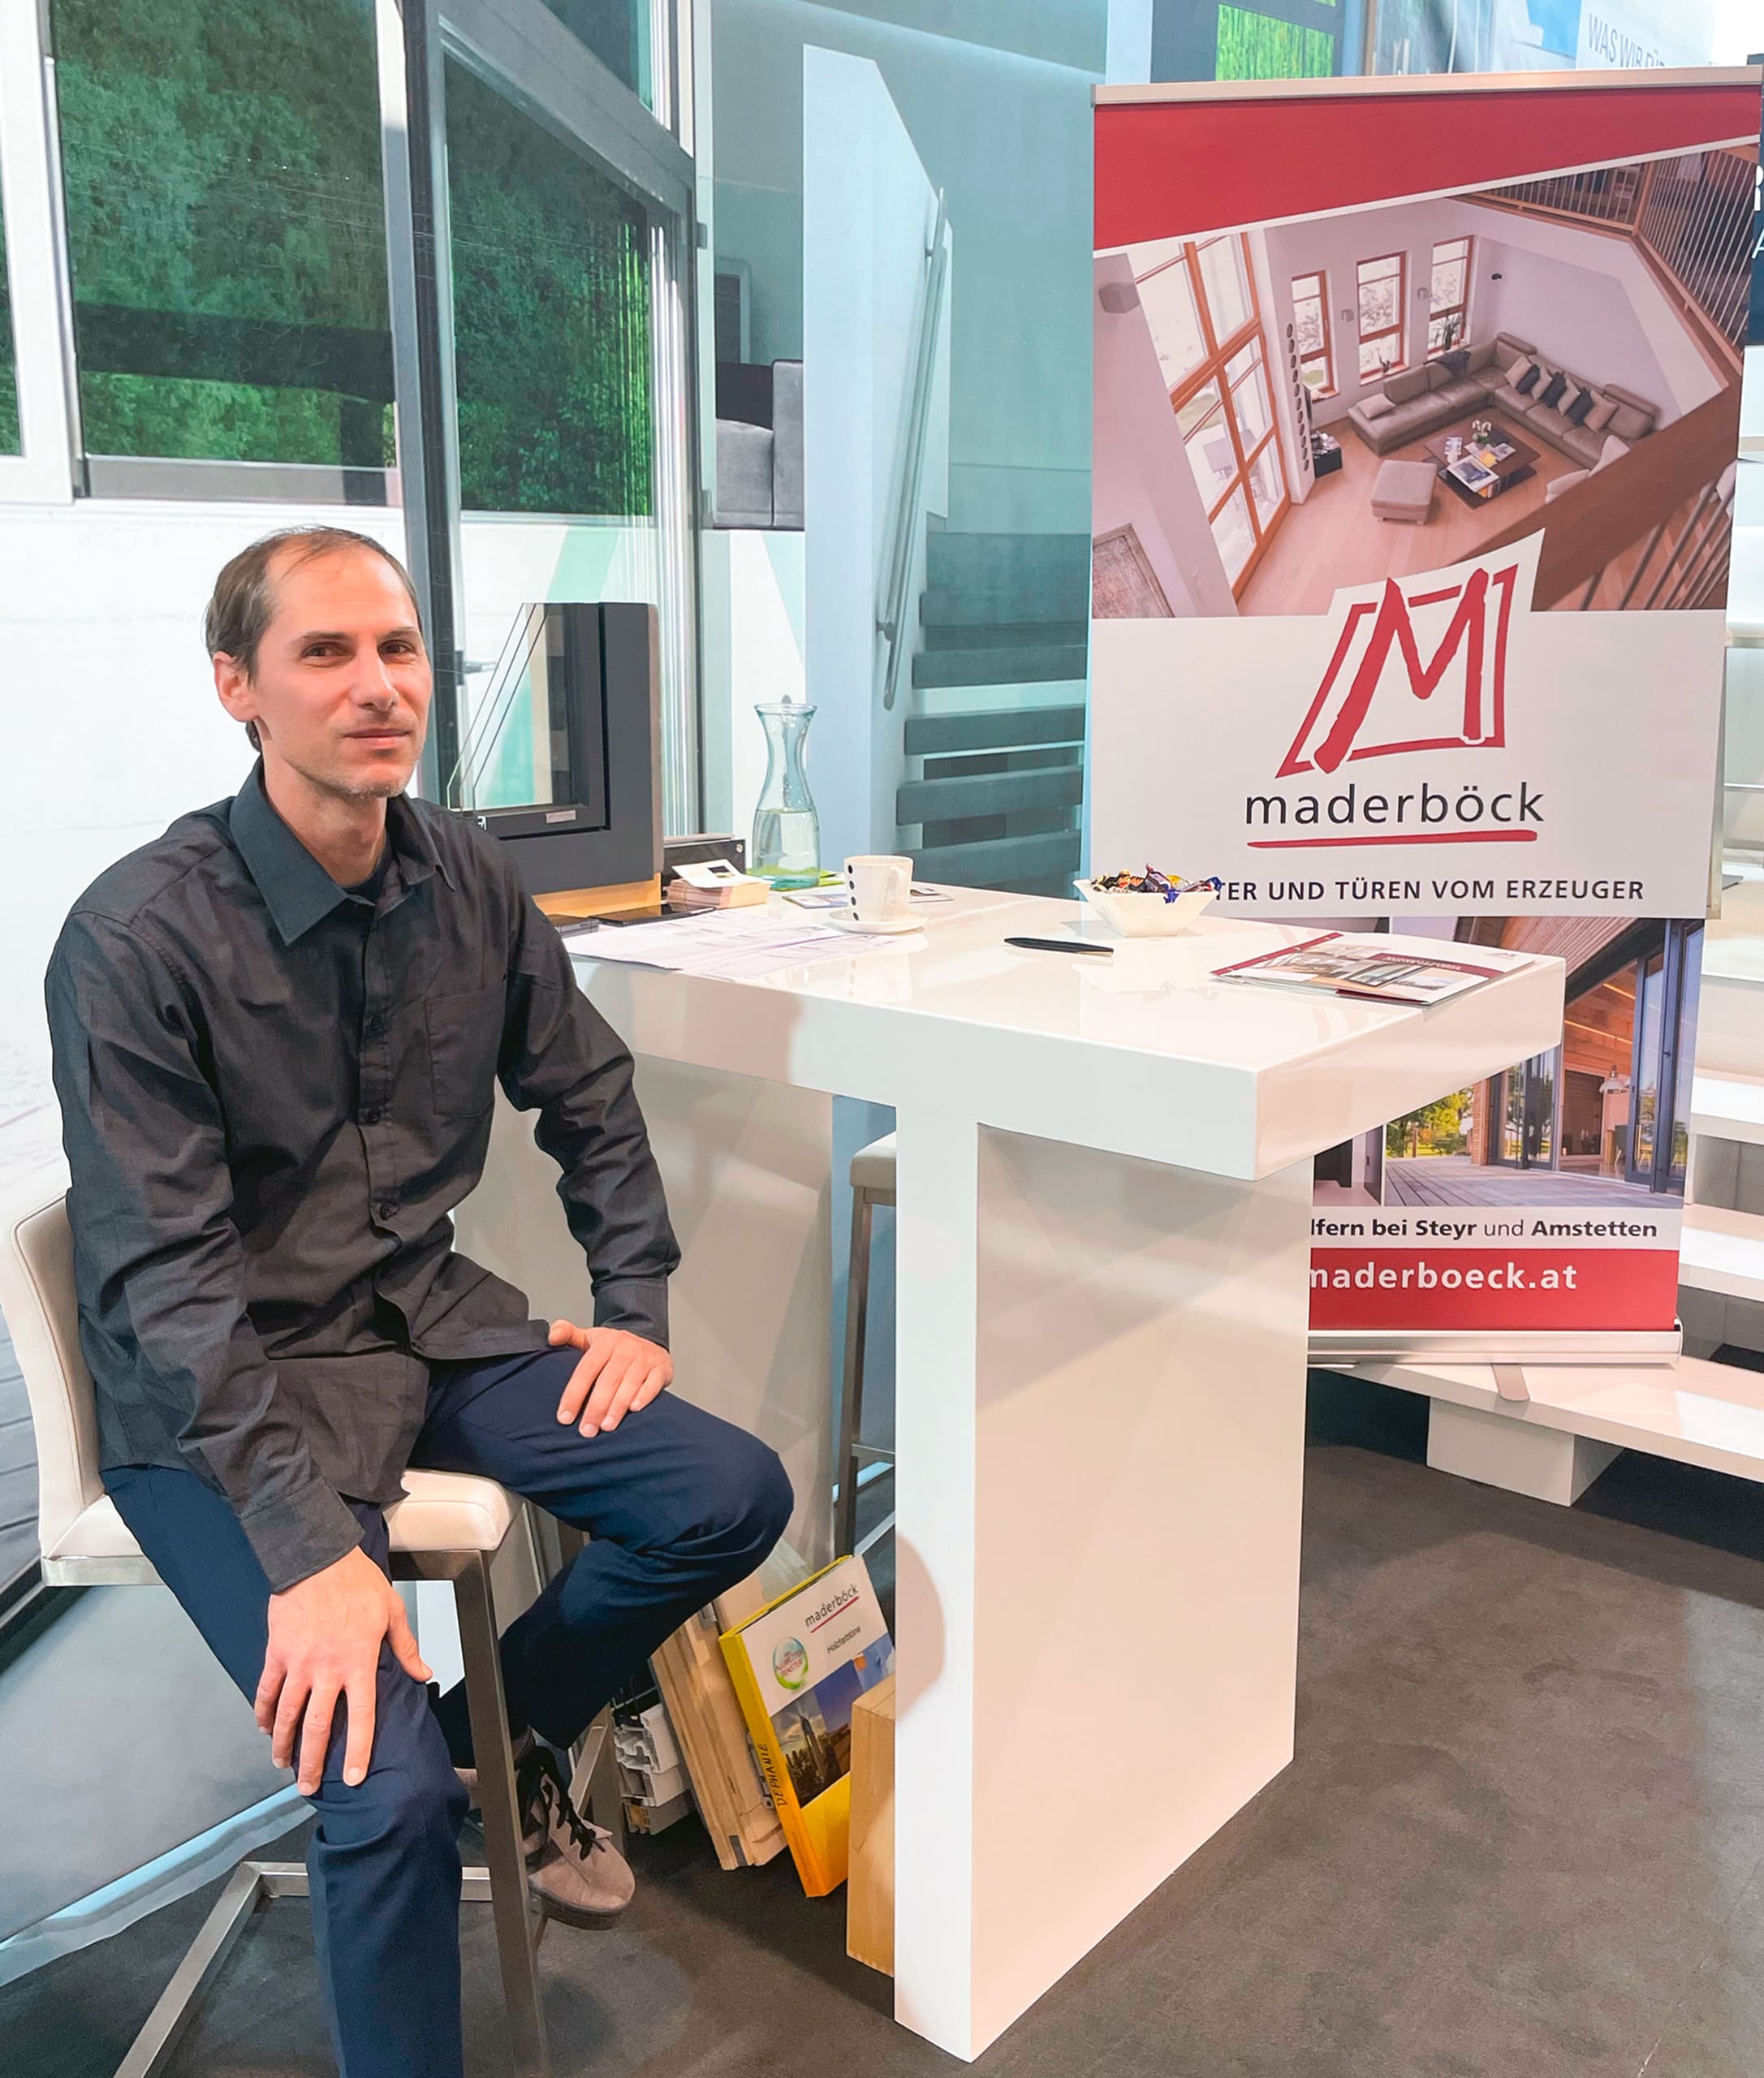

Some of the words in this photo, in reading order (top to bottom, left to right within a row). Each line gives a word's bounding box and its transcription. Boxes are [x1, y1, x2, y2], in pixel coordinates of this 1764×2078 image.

[1589, 13, 1618, 63] WAS
[1245, 782, 1544, 825] maderböck
[1269, 882, 1324, 900] UND
[1335, 877, 1421, 899] TÜREN
[1431, 881, 1494, 899] VOM
[1507, 880, 1644, 899] ERZEUGER
[1372, 1218, 1408, 1236] bei
[1416, 1219, 1477, 1240] Steyr
[1484, 1219, 1524, 1237] und
[1531, 1220, 1657, 1237] Amstetten
[804, 1584, 859, 1627] maderböck
